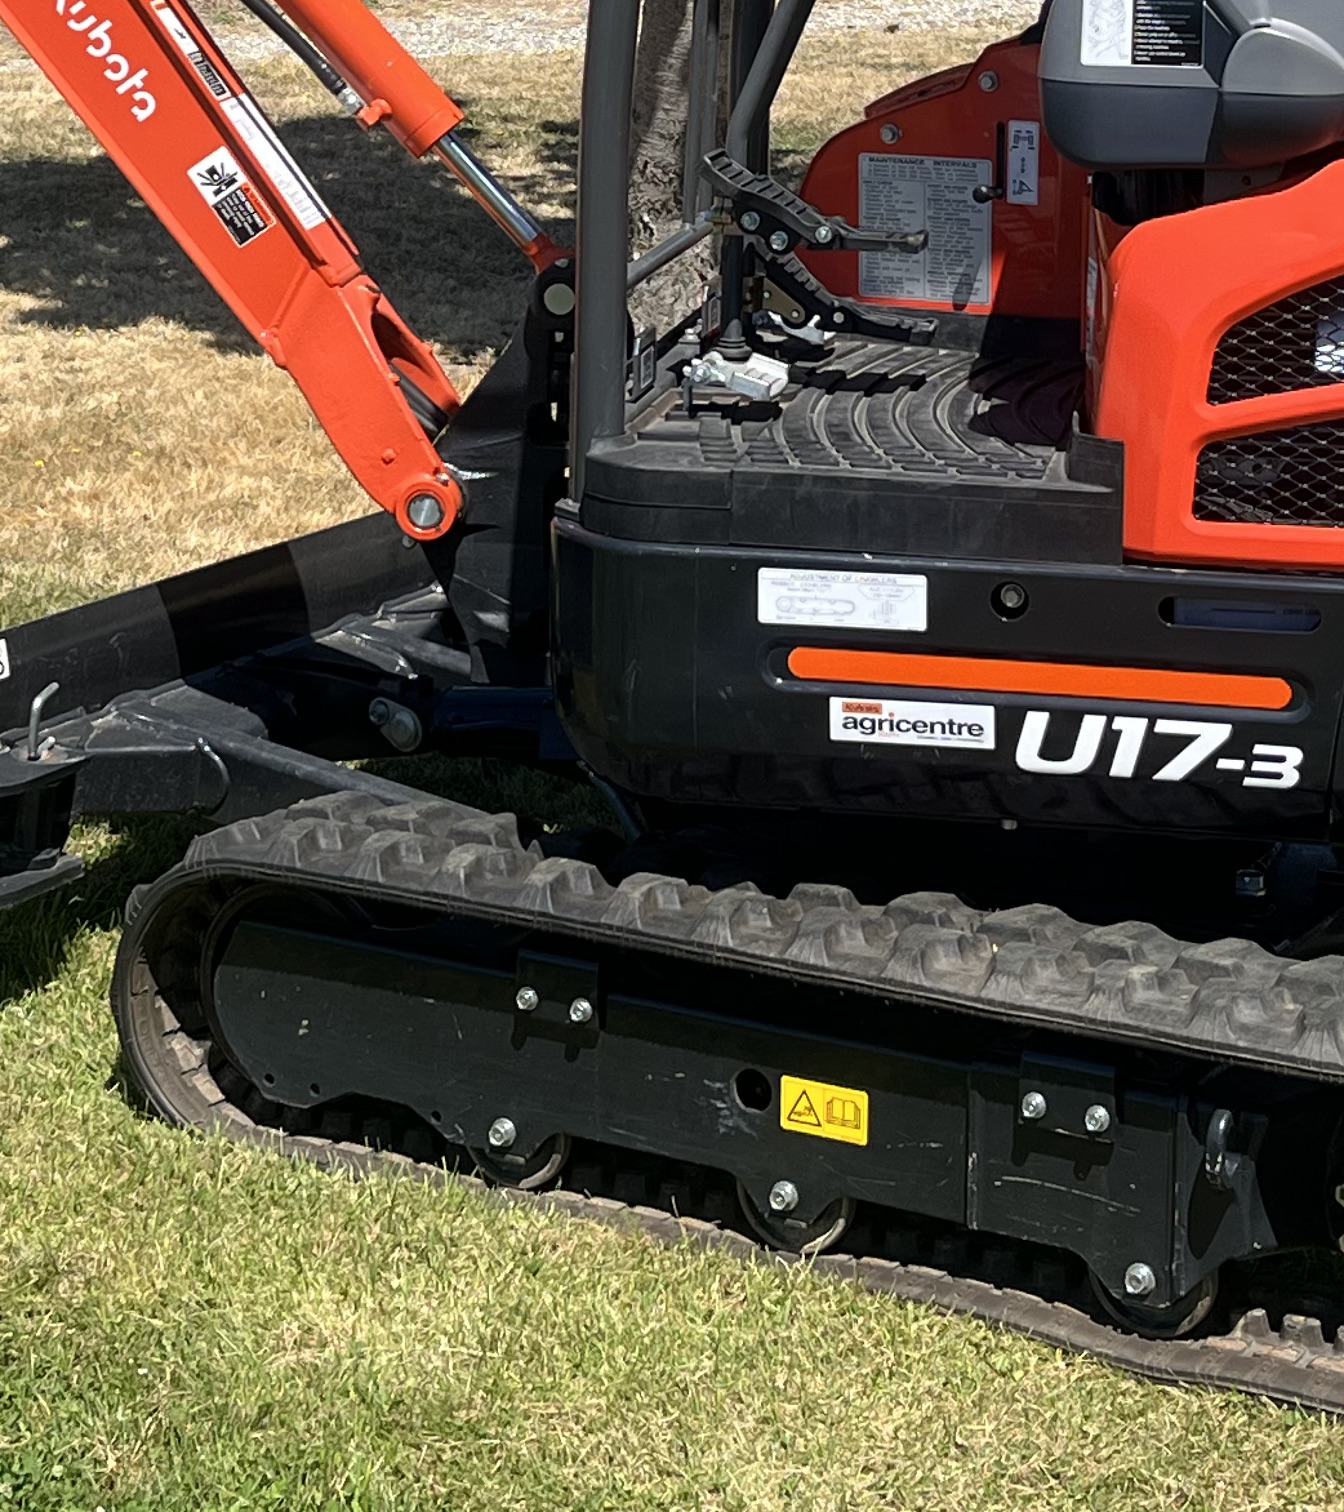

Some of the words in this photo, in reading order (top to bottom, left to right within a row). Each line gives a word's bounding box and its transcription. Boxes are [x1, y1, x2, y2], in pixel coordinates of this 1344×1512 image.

[868, 156, 925, 166] MAINTENANCE
[933, 160, 977, 169] INTERVALS
[842, 711, 984, 737] agricentre
[1015, 709, 1304, 789] U17-3
